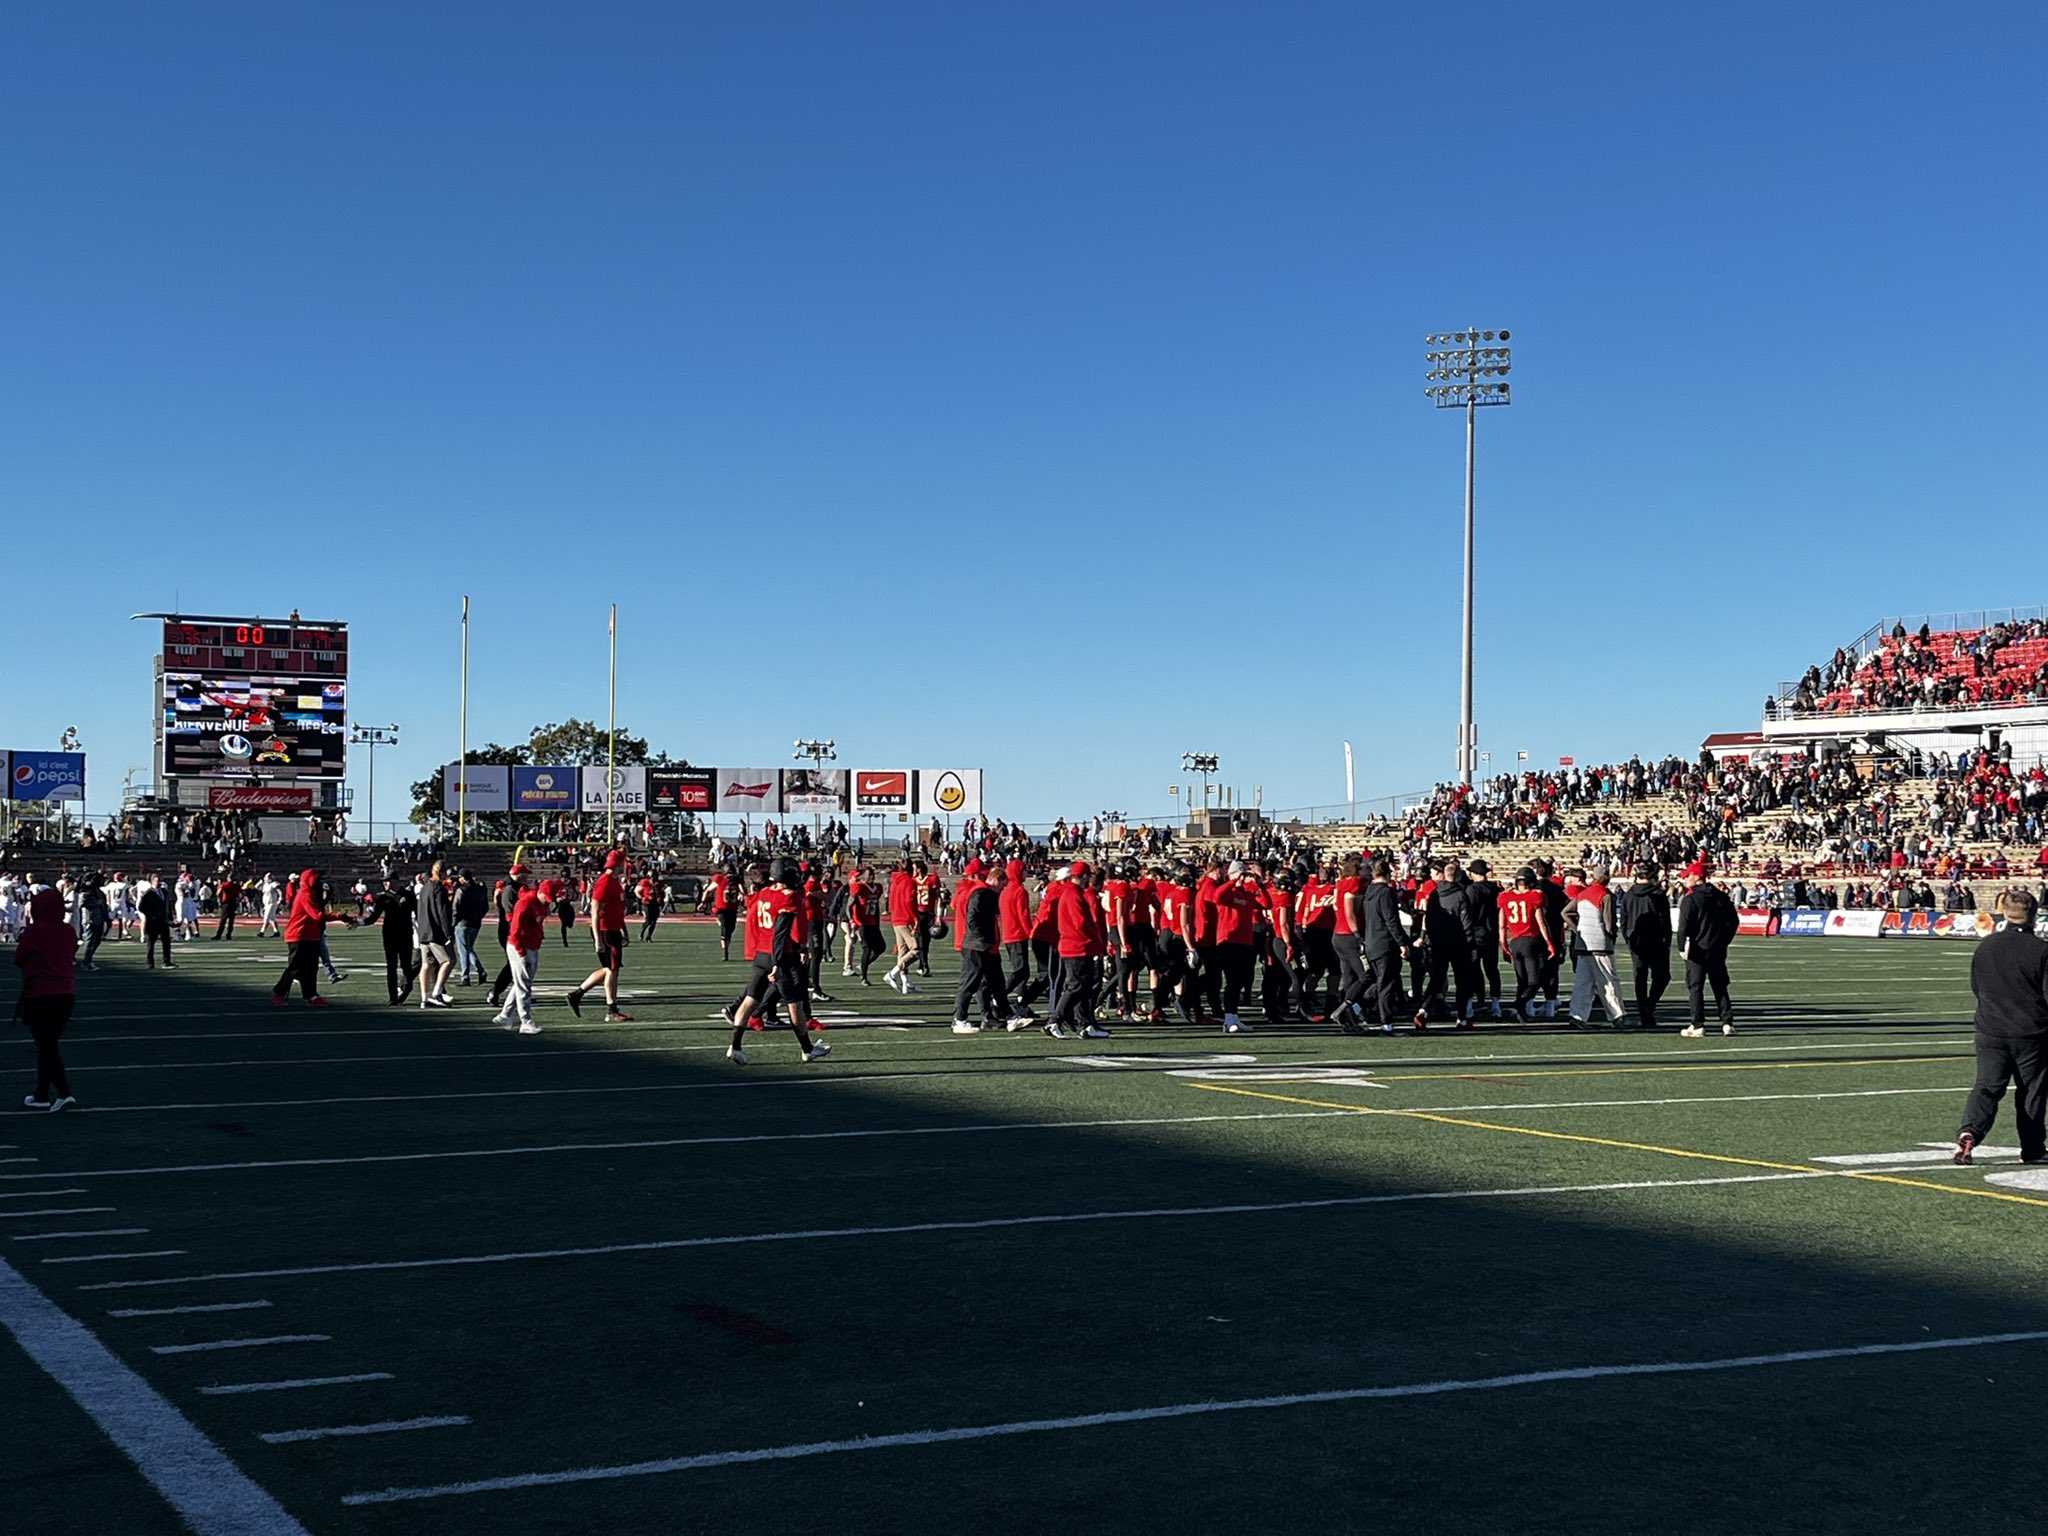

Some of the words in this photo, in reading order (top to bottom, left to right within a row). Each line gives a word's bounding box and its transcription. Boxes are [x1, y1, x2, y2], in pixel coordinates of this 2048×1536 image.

[37, 769, 81, 784] pepsi
[211, 789, 308, 805] Budweiser
[585, 792, 603, 804] LA
[606, 792, 643, 804] CAGE
[681, 791, 695, 803] 10
[916, 890, 929, 906] 12
[1507, 901, 1528, 924] 31
